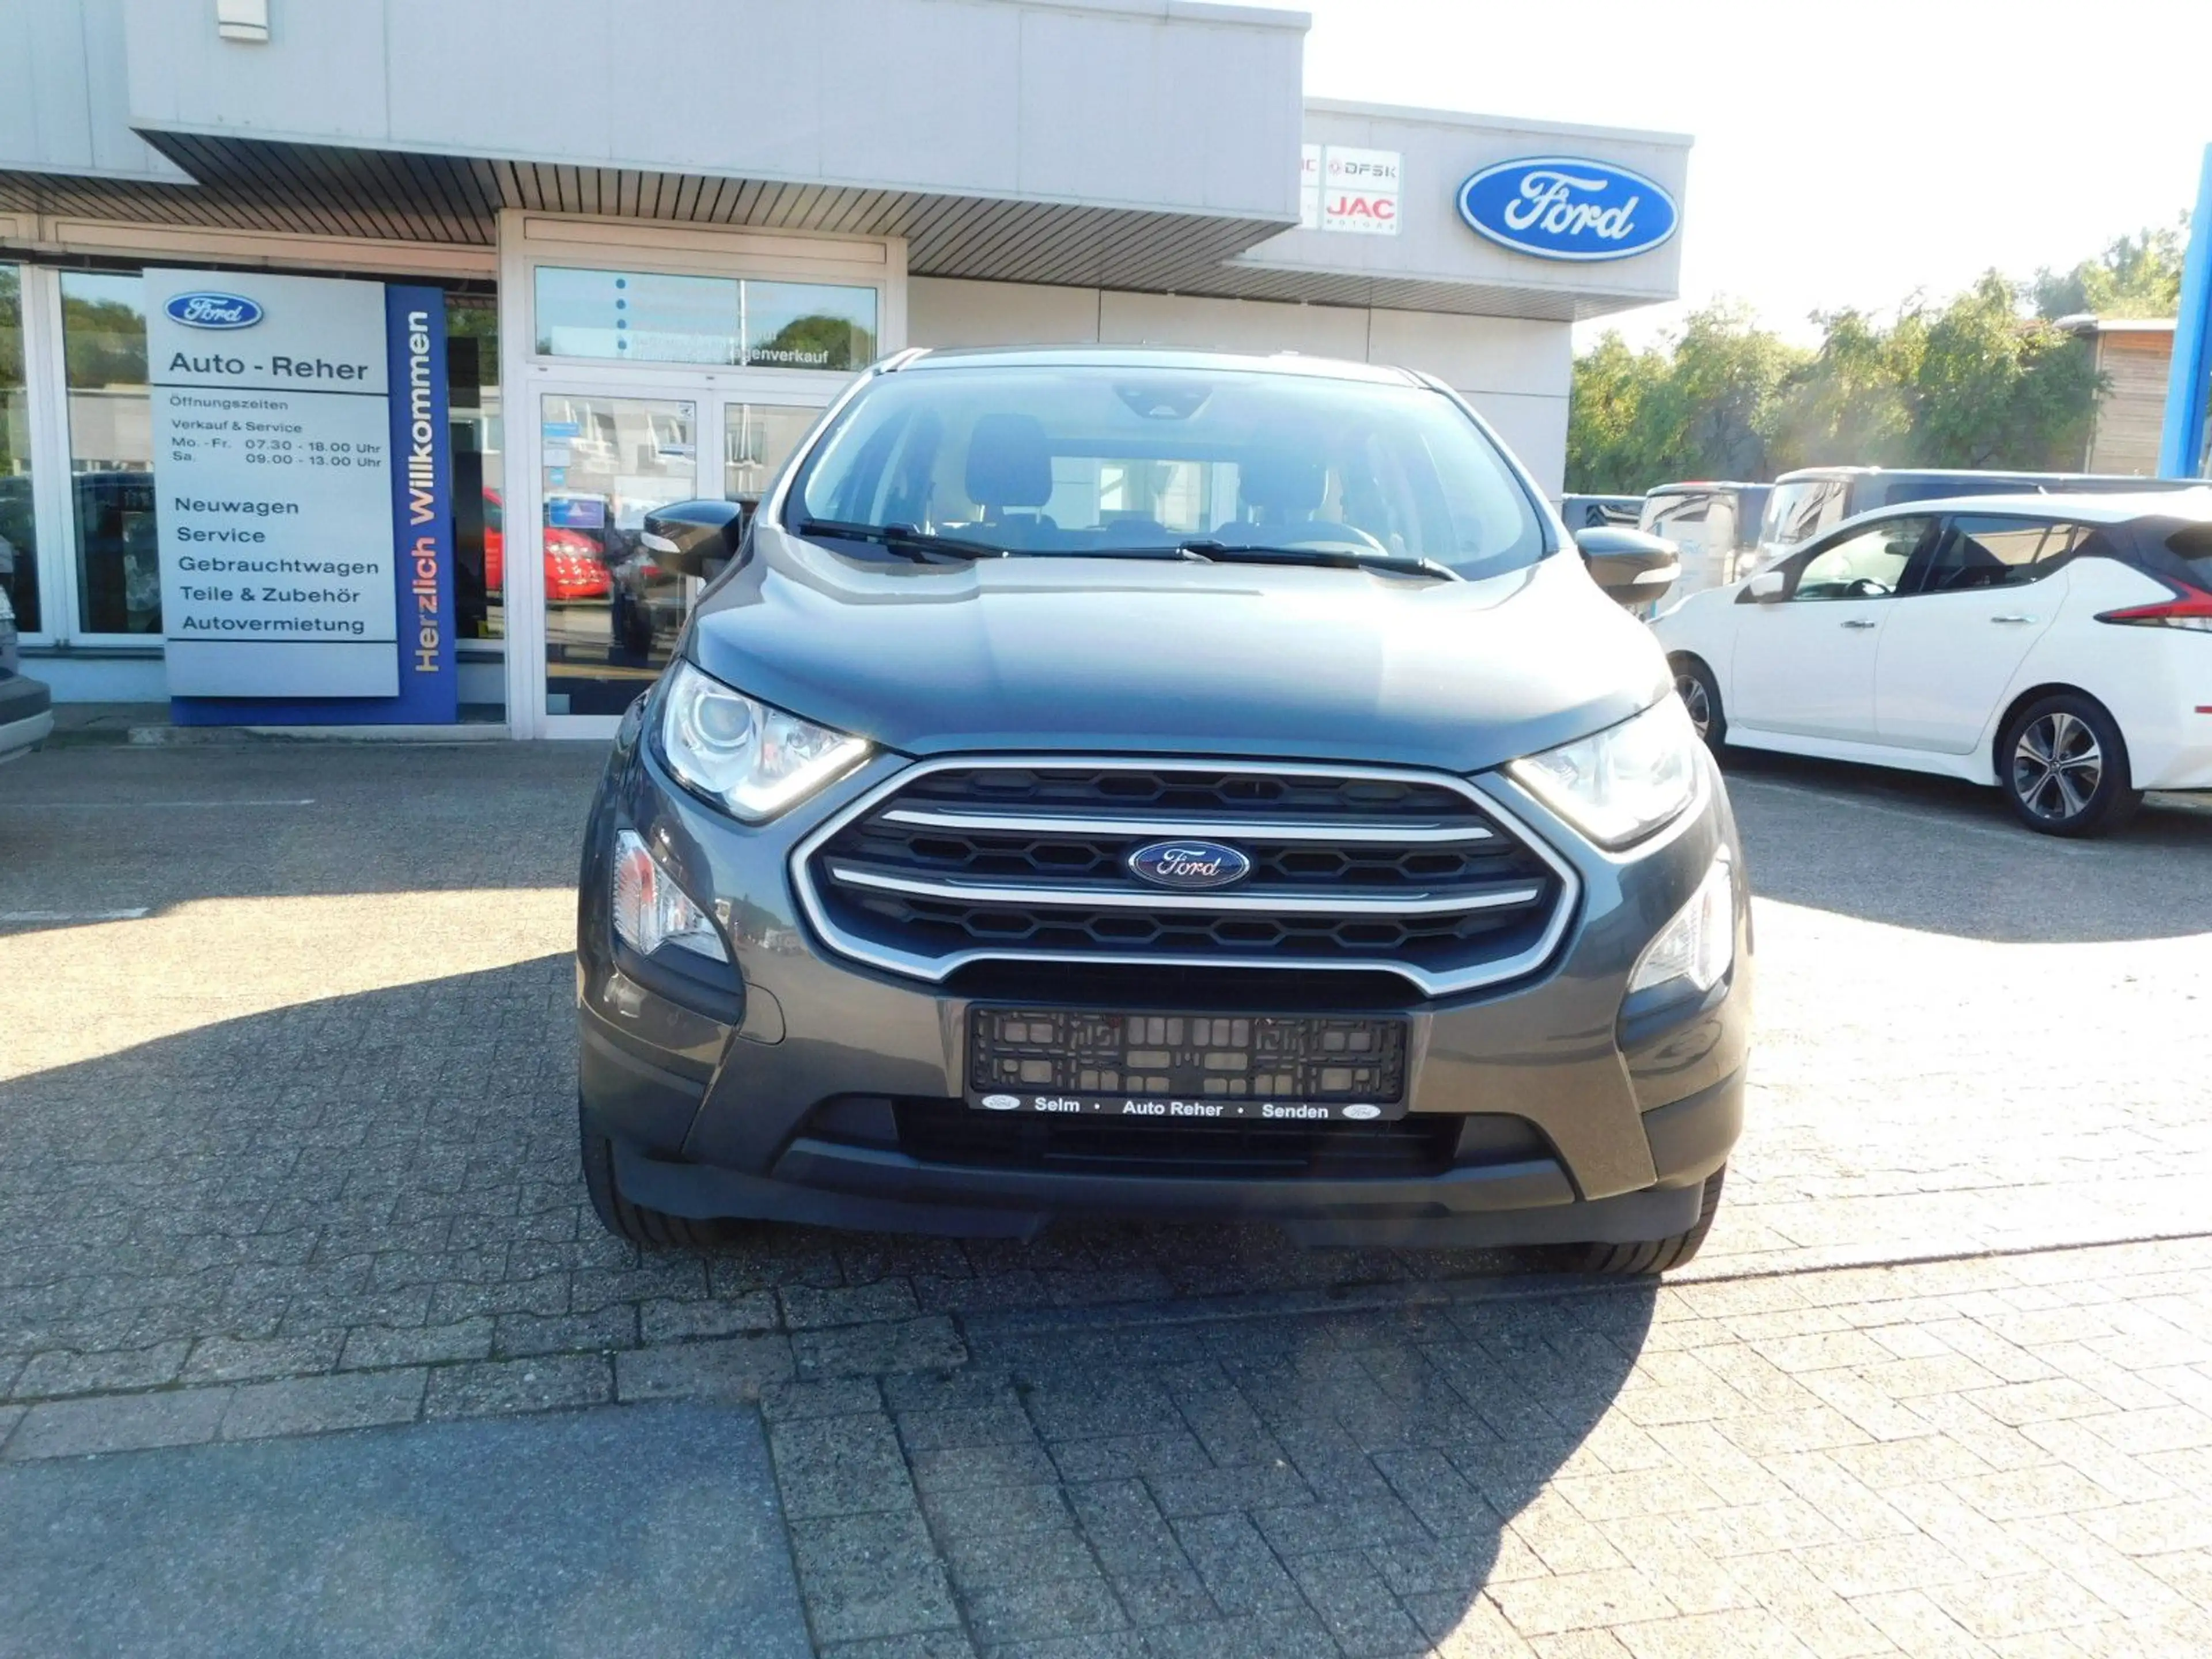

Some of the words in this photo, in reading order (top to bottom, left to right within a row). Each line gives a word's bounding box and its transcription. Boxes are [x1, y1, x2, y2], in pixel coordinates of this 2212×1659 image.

[1344, 162, 1396, 177] DFSK
[1326, 196, 1395, 219] JAC
[1504, 171, 1639, 240] Ford
[184, 297, 243, 323] Ford
[730, 348, 829, 363] agenverkauf
[169, 353, 244, 374] Auto
[272, 356, 368, 380] Reher
[170, 395, 289, 410] Öffnungszeiten
[172, 419, 229, 431] Verkauf
[232, 421, 241, 431] &
[245, 422, 302, 433] Service
[408, 311, 434, 526] Willkommen
[245, 440, 292, 450] 07.30
[308, 442, 351, 453] 18.00
[357, 443, 381, 453] Uhr
[246, 453, 293, 464] 09.00
[309, 456, 351, 467] 13.00
[357, 457, 381, 467] Uhr
[175, 497, 299, 516] Neuwagen
[177, 527, 266, 543] Service
[179, 556, 379, 577] Gebrauchtwagen
[180, 586, 233, 601] Teile
[241, 587, 255, 601] &
[263, 588, 361, 604] Zubehör
[411, 537, 440, 672] Herzlich
[183, 616, 365, 635] Autovermietung
[1156, 848, 1222, 878] Ford
[1035, 1097, 1080, 1113] Selm
[1123, 1100, 1165, 1115] Auto
[1171, 1101, 1223, 1116] Reher
[1262, 1104, 1329, 1119] Senden
